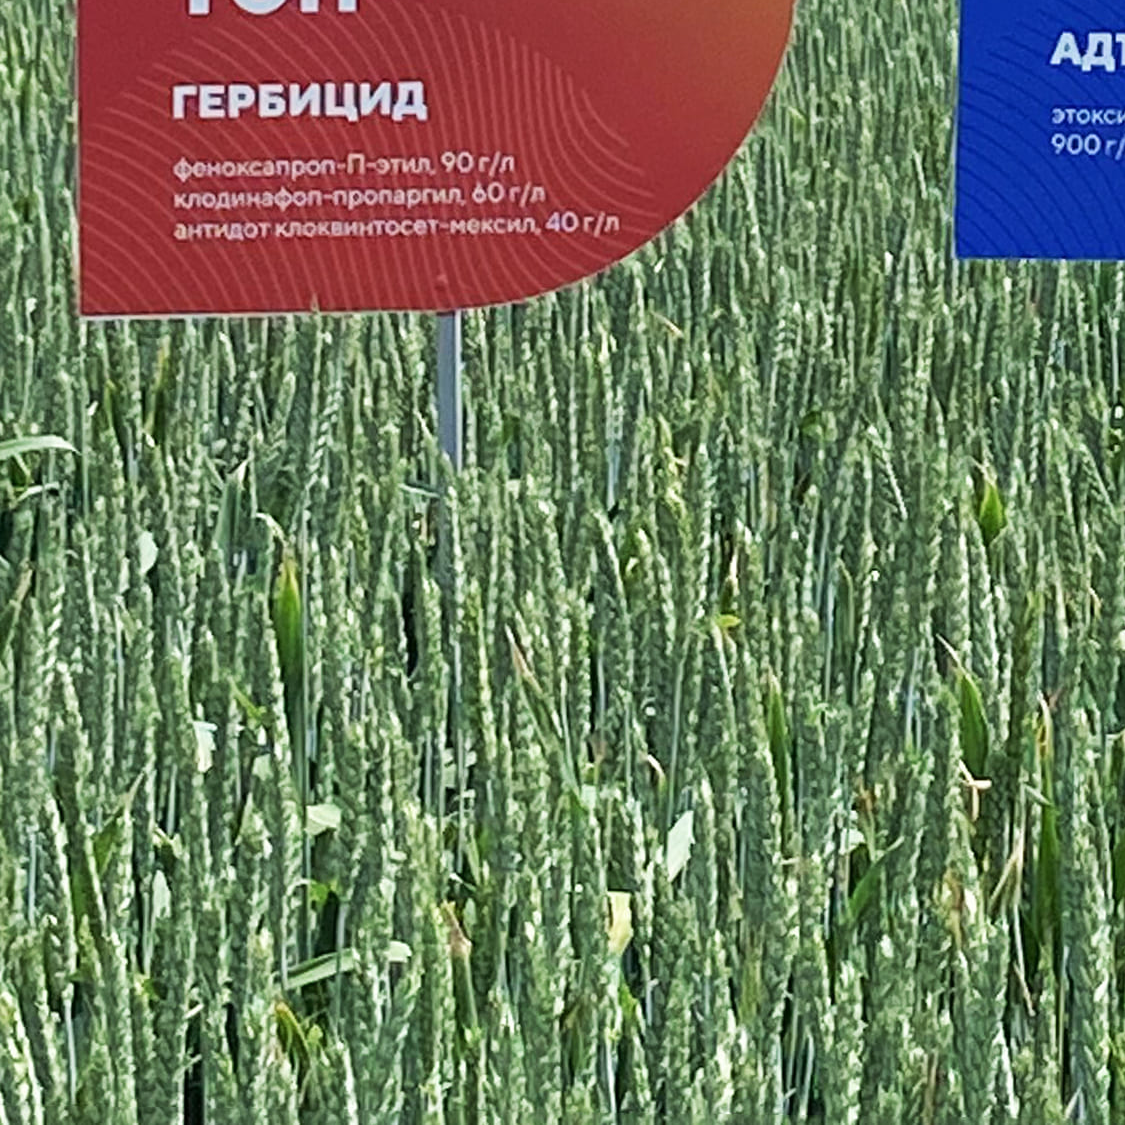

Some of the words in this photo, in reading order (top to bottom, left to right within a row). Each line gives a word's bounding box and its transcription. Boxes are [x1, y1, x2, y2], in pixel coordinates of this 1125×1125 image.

[171, 81, 428, 122] ГЕРБИЦИД
[1051, 133, 1101, 155] 900
[441, 151, 474, 174] 90
[478, 151, 515, 178] г/л
[472, 181, 505, 204] 60
[509, 181, 546, 208] г/л
[174, 221, 271, 241] антидот
[545, 211, 579, 233] 40
[583, 211, 620, 238] г/л
